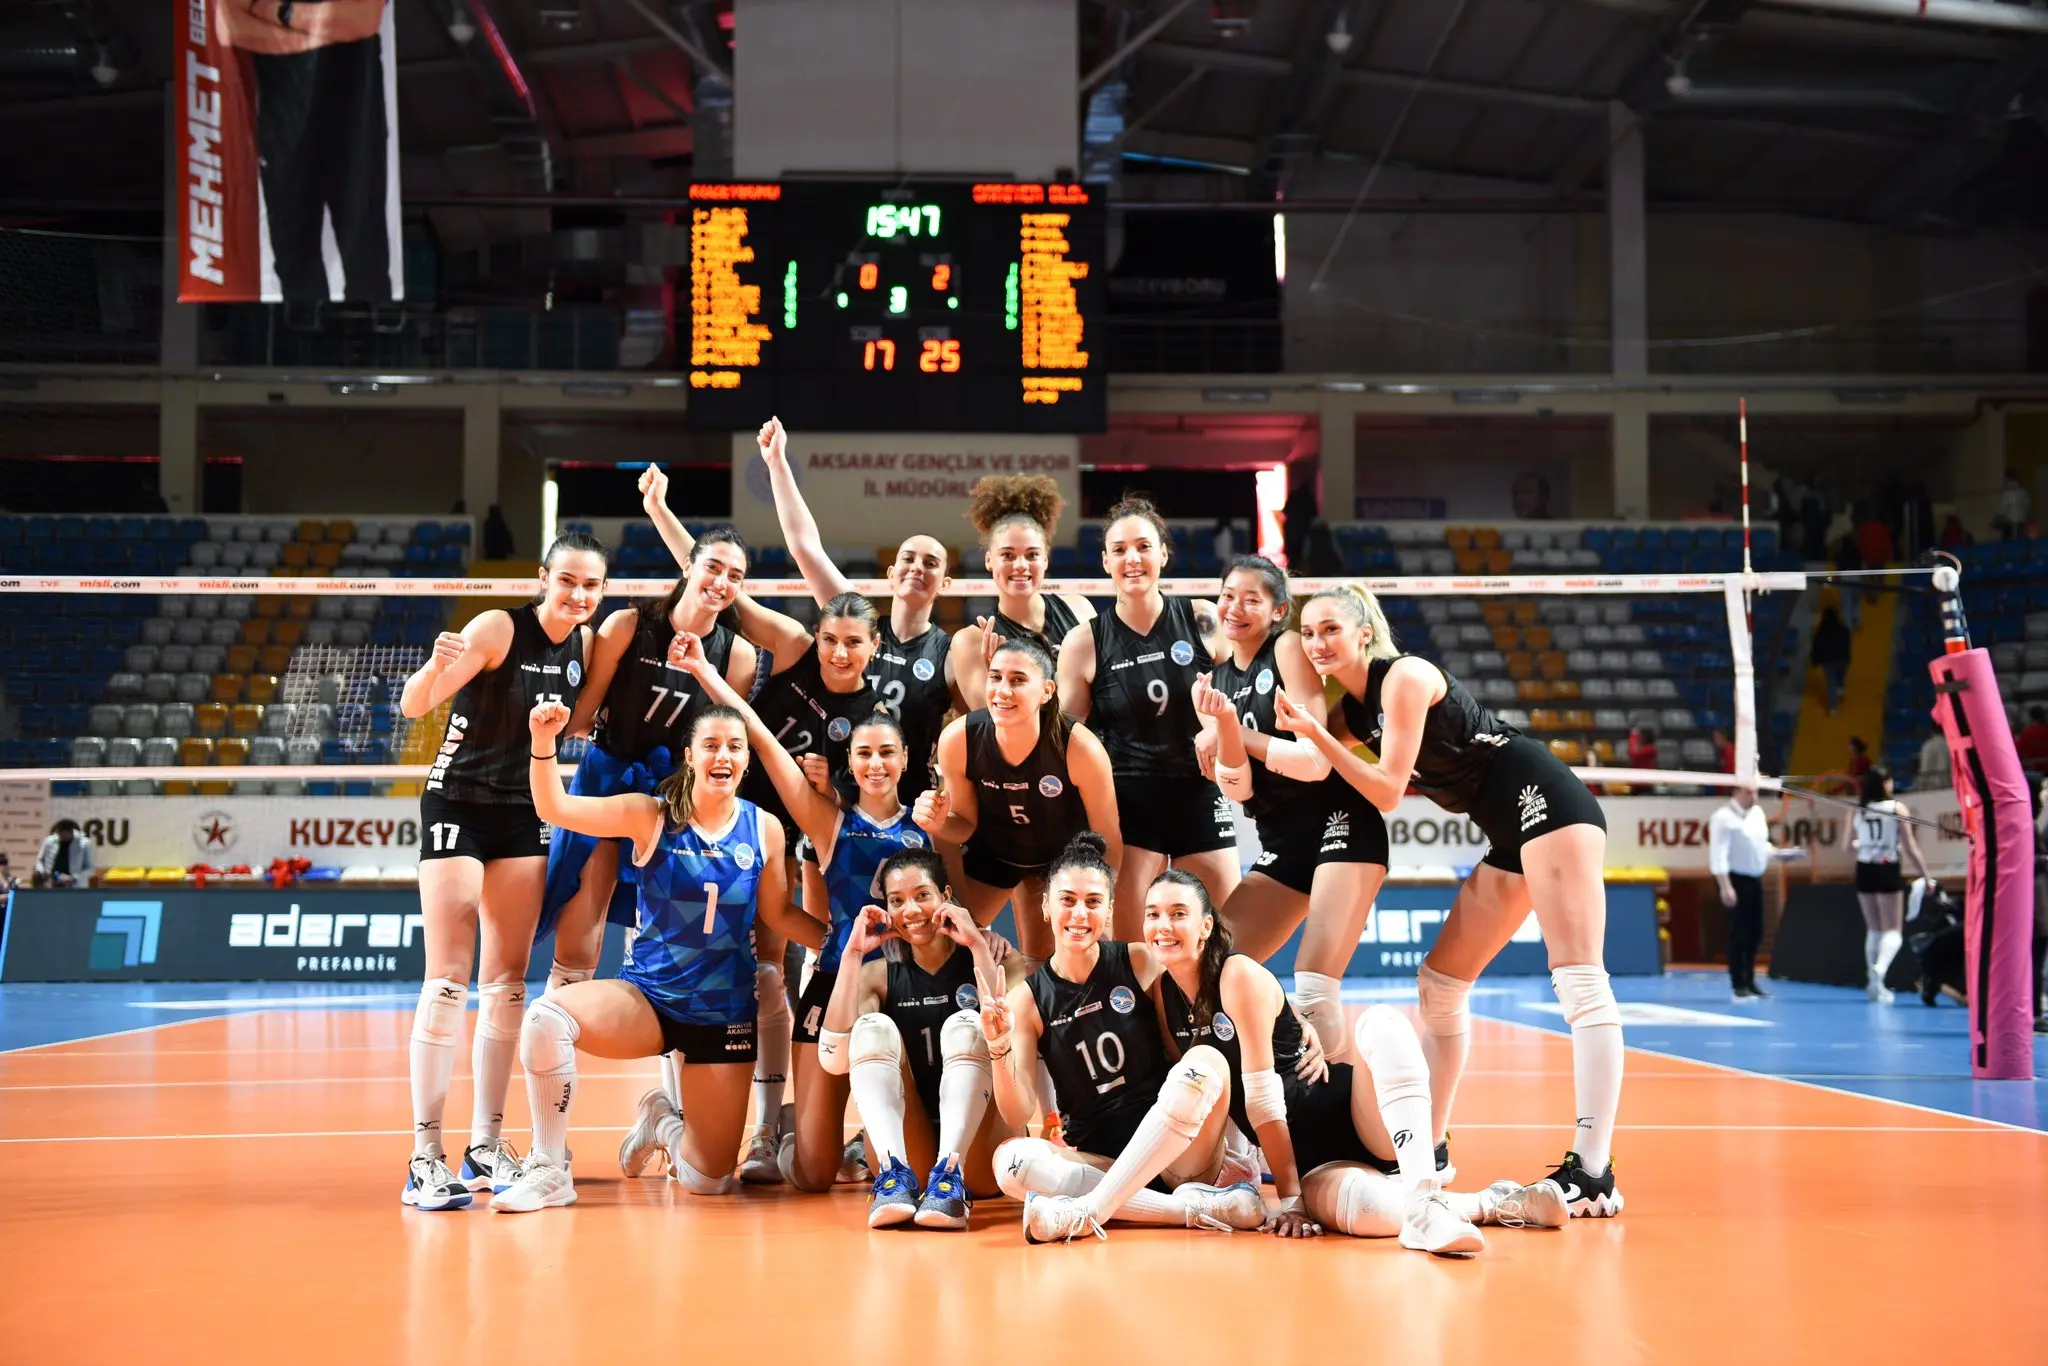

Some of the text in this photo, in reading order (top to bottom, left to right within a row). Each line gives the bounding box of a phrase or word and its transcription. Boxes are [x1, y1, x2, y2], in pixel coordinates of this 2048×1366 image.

[186, 50, 224, 285] MEHMET
[859, 263, 878, 290] 0
[932, 264, 951, 291] 2
[889, 286, 908, 314] 3
[864, 340, 896, 371] 17
[919, 339, 961, 373] 25
[808, 453, 898, 470] AKSARAY
[990, 454, 1014, 470] VE
[1018, 454, 1071, 471] SPOR
[886, 476, 978, 497] MÜDÜRL
[79, 580, 141, 589] misli.com
[199, 581, 259, 589] misli.com
[316, 582, 376, 590] misli.com
[432, 582, 492, 590] misli.com
[644, 685, 691, 728] 77
[1147, 679, 1169, 717] 9
[1009, 804, 1031, 825] 5
[430, 822, 460, 851] 17
[703, 882, 719, 935] 1
[297, 954, 397, 971] PREFABRİK
[803, 1005, 823, 1036] 4
[1075, 1031, 1126, 1081] 10
